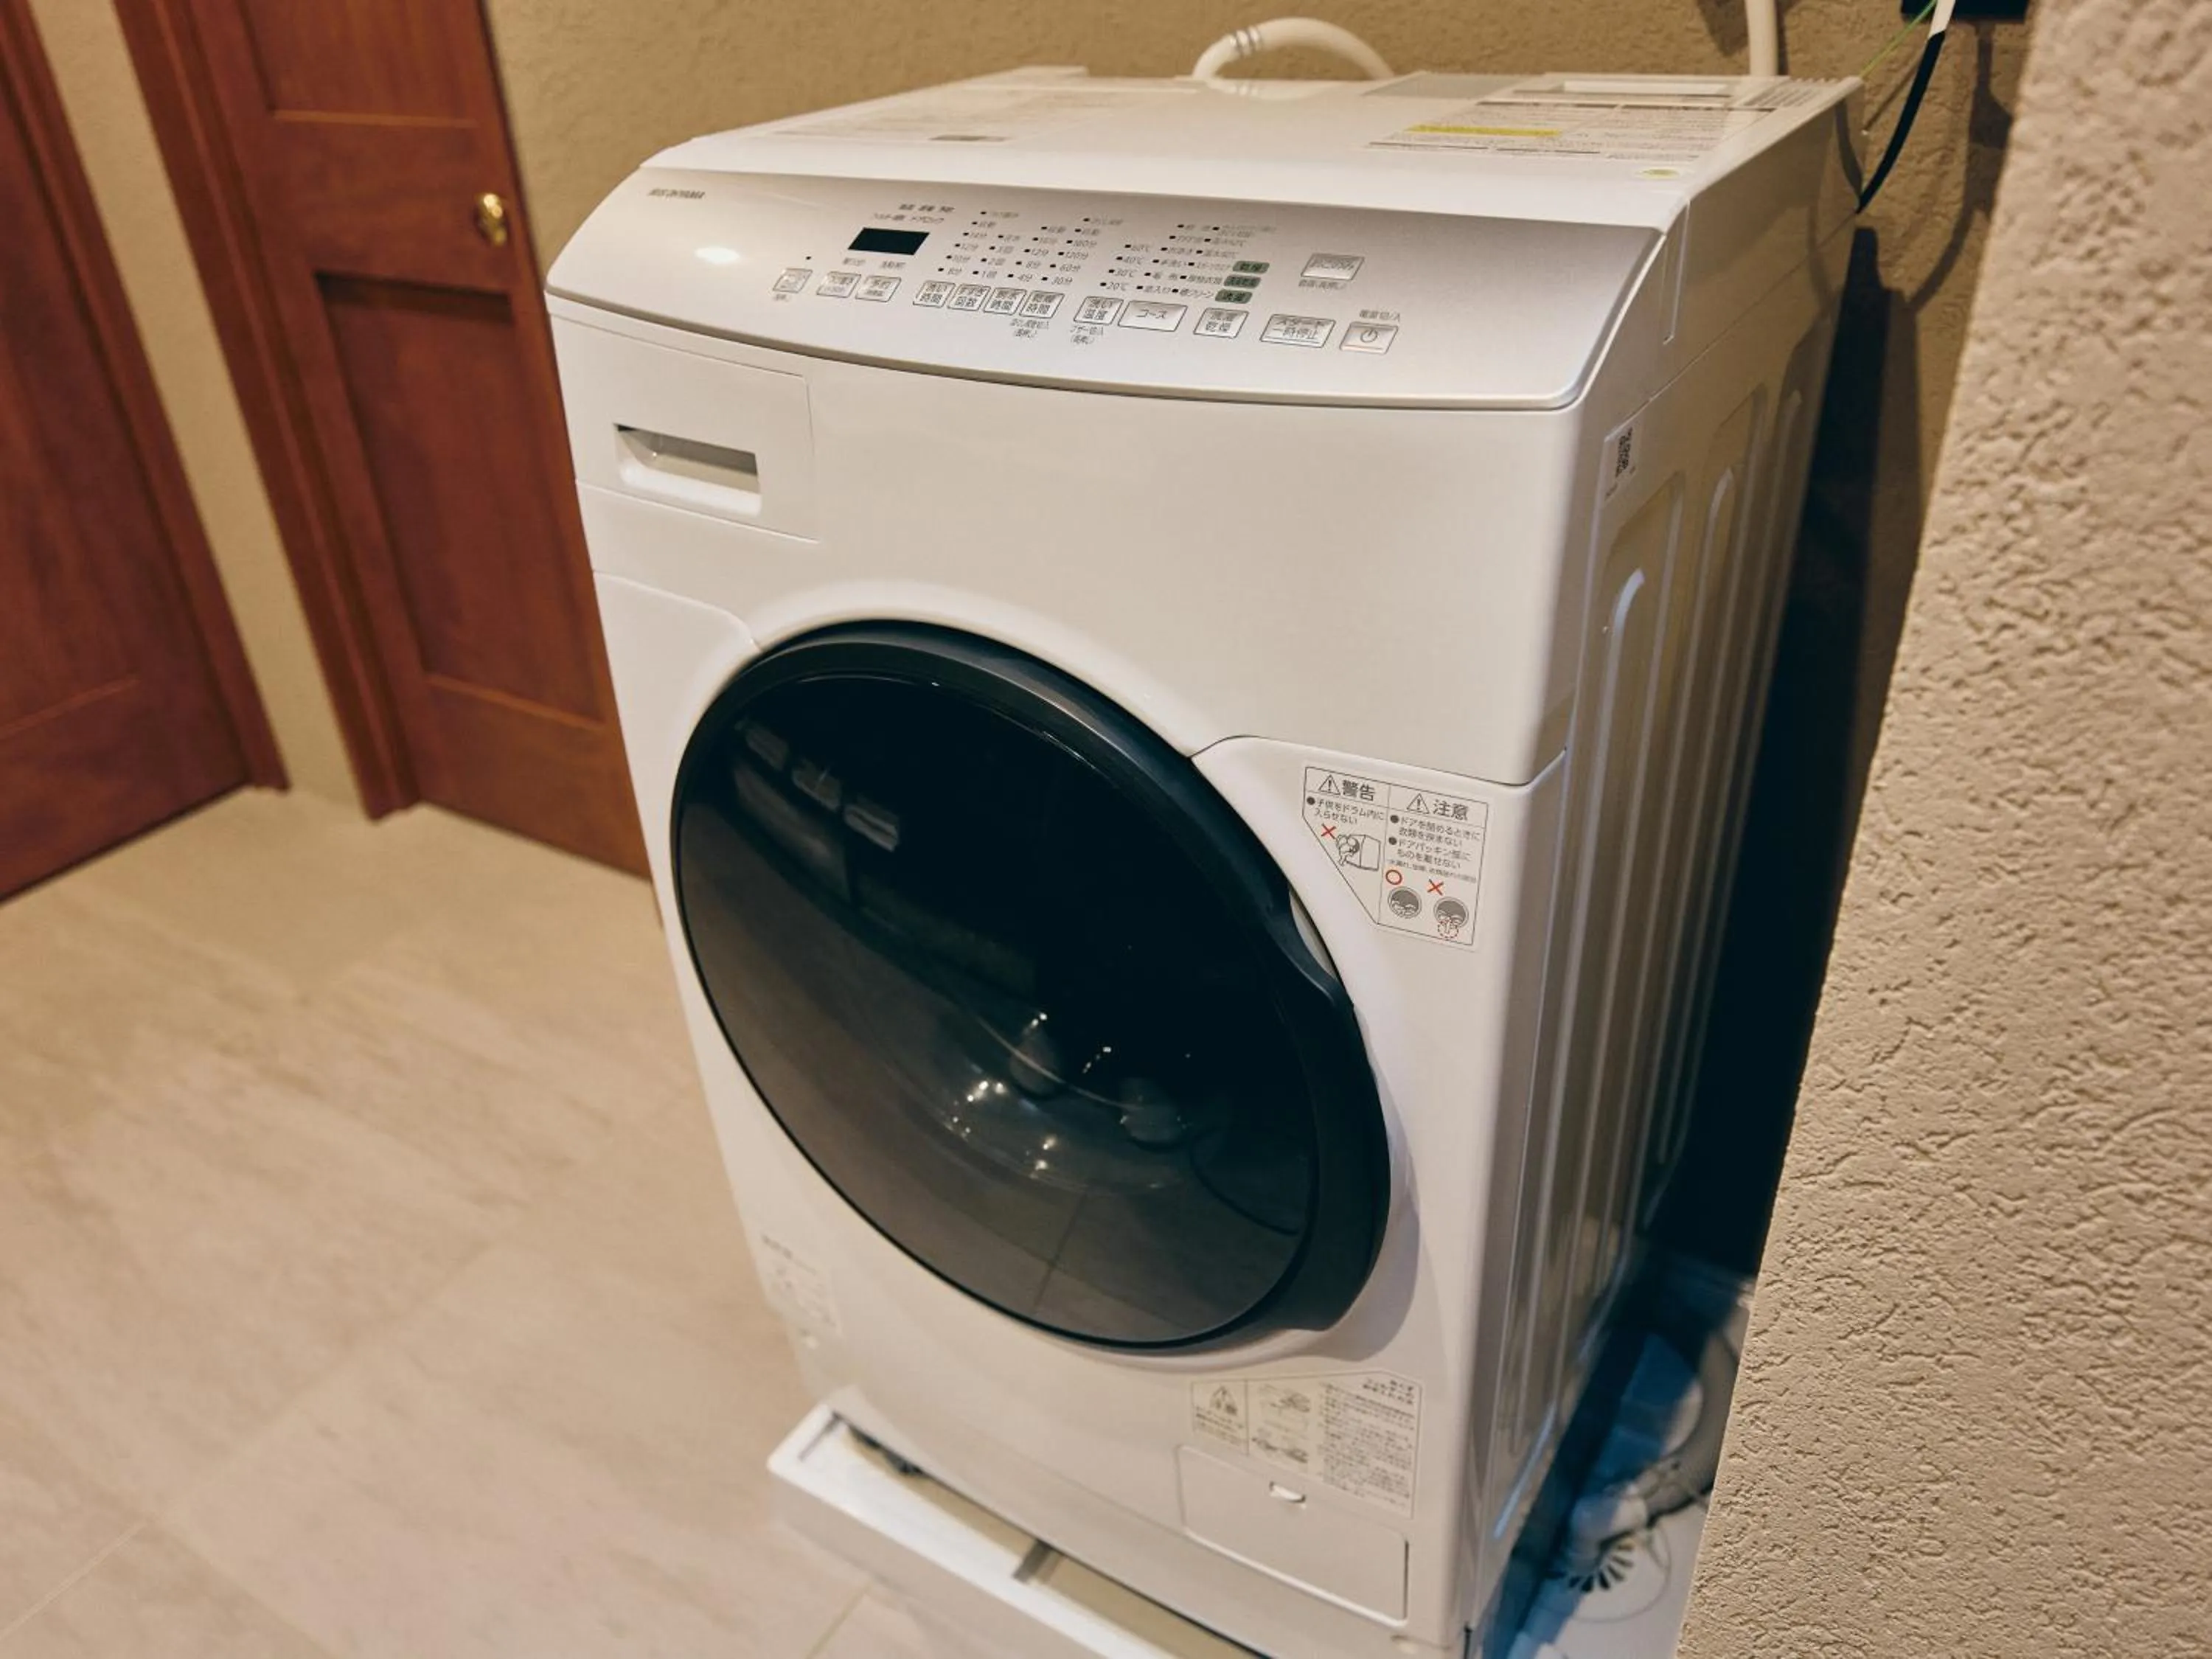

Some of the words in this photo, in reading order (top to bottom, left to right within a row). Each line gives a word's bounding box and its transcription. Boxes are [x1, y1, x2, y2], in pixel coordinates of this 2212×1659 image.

[1135, 307, 1168, 319] コース
[1342, 779, 1376, 801] 警告
[1433, 798, 1469, 821] 注意
